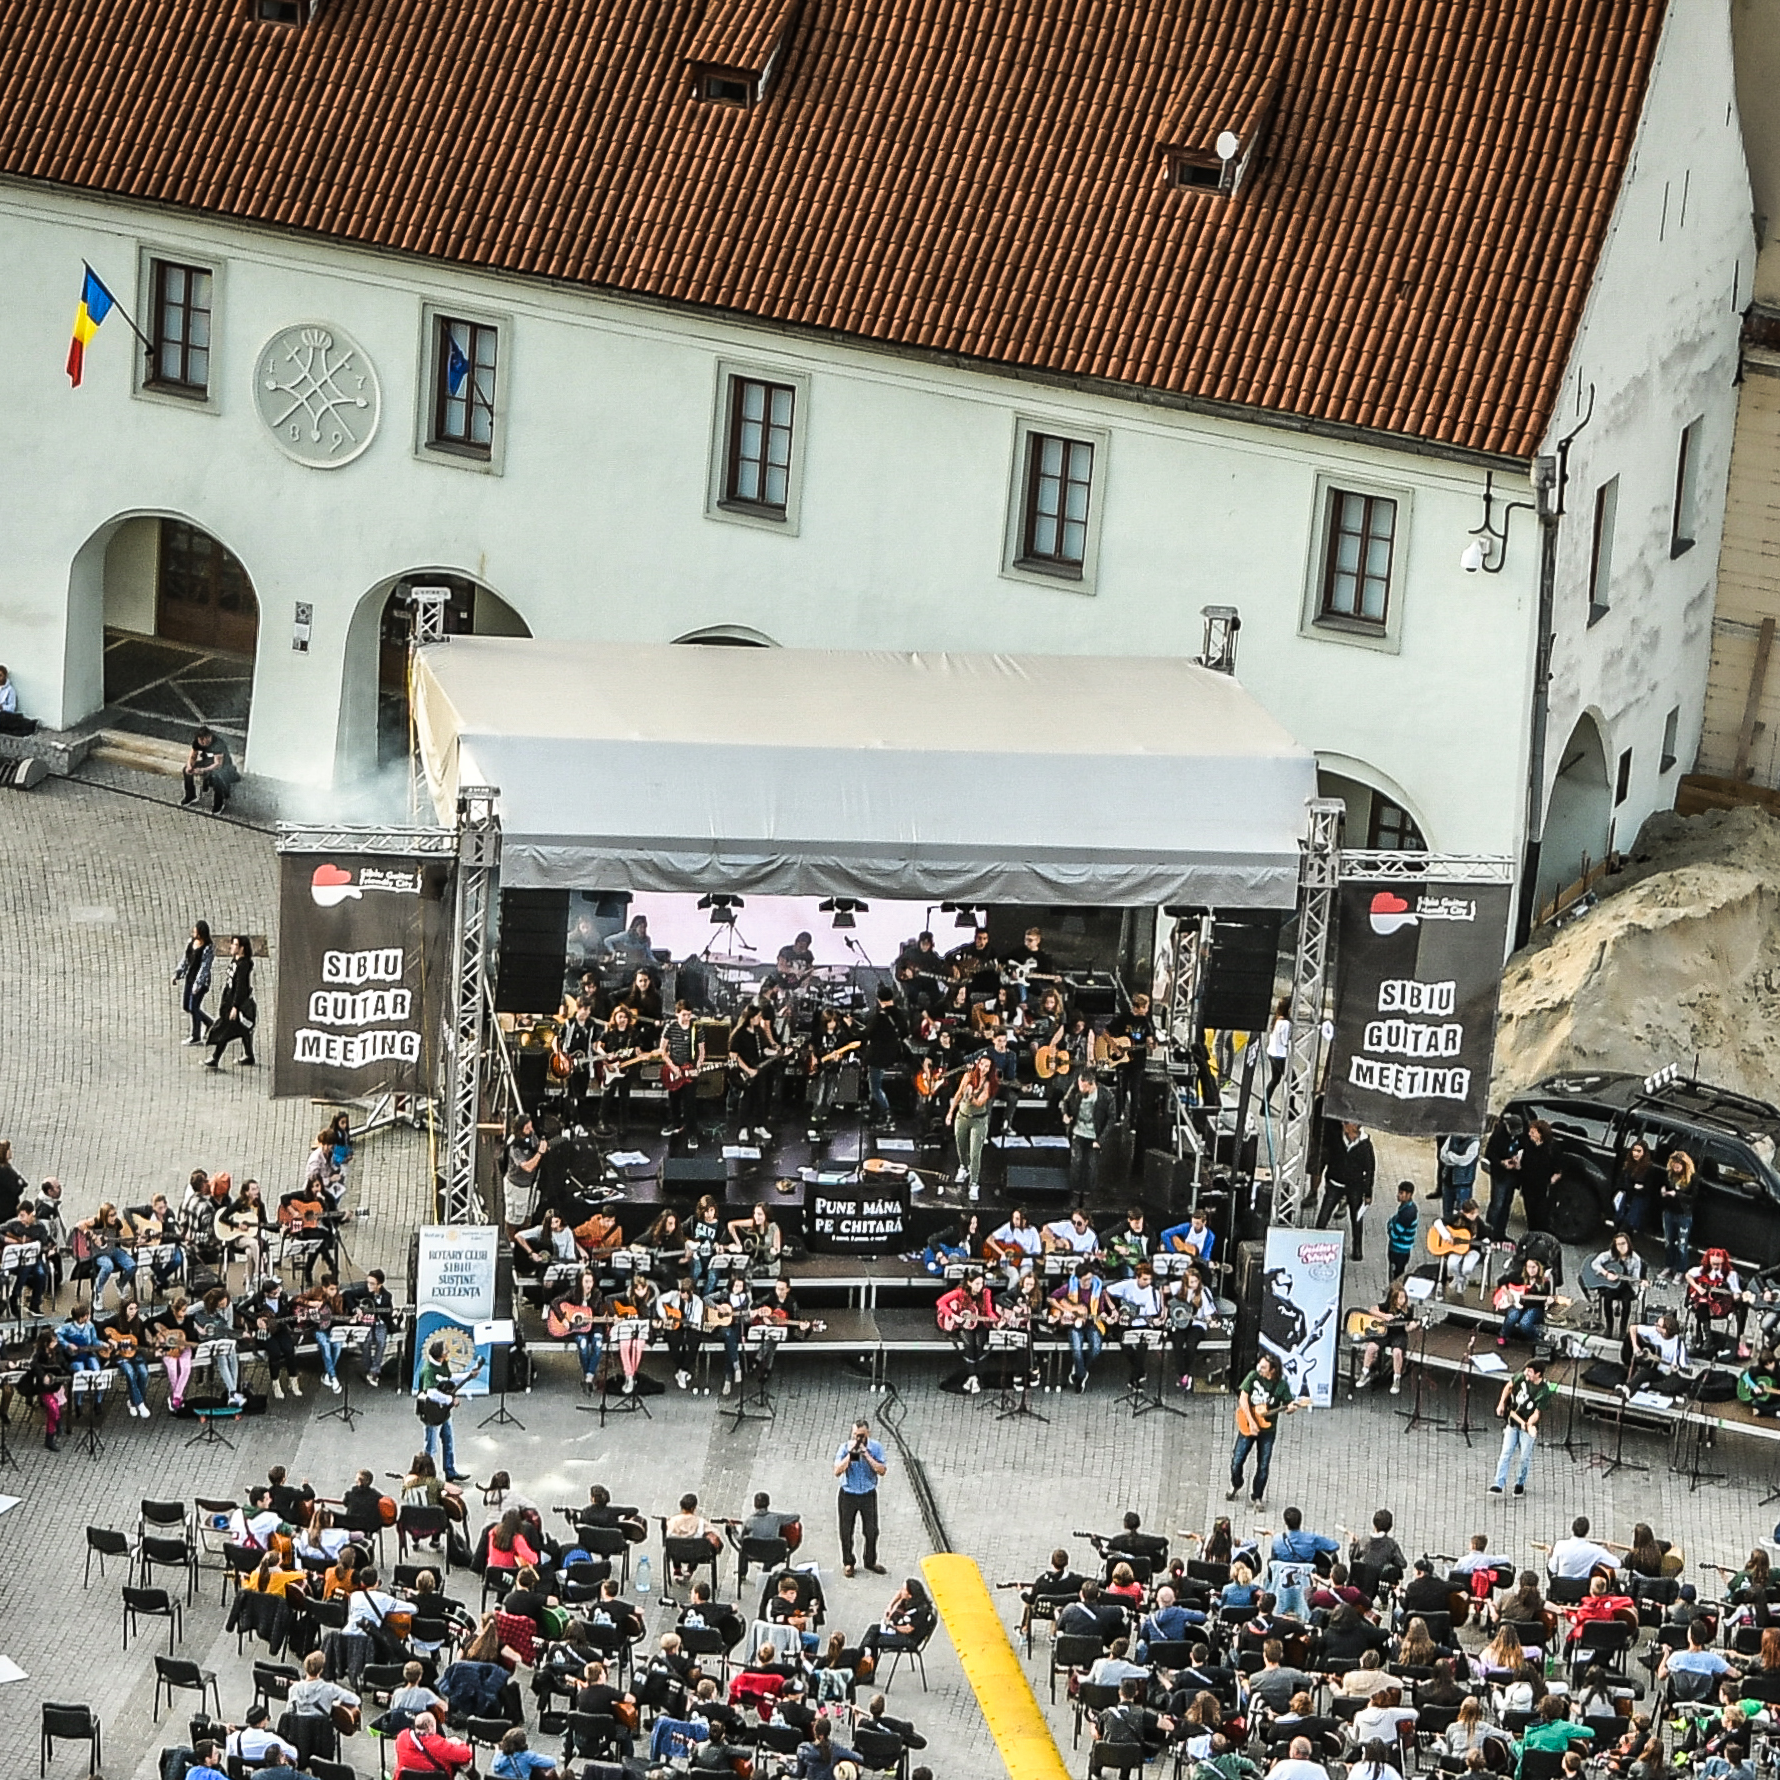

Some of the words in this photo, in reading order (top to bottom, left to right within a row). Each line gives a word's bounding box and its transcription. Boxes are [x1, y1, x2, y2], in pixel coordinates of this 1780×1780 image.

[325, 952, 400, 979] SIBIU
[313, 992, 412, 1021] GUITAR
[1381, 982, 1452, 1012] SIBIU
[300, 1033, 417, 1063] MEETING
[1366, 1025, 1459, 1053] GUITAR
[1354, 1062, 1465, 1095] MEETING
[815, 1198, 856, 1215] PUNE
[815, 1218, 834, 1233] PE
[428, 1250, 464, 1261] ROTARY
[464, 1250, 488, 1261] CLUB
[443, 1261, 471, 1272] SIBIU
